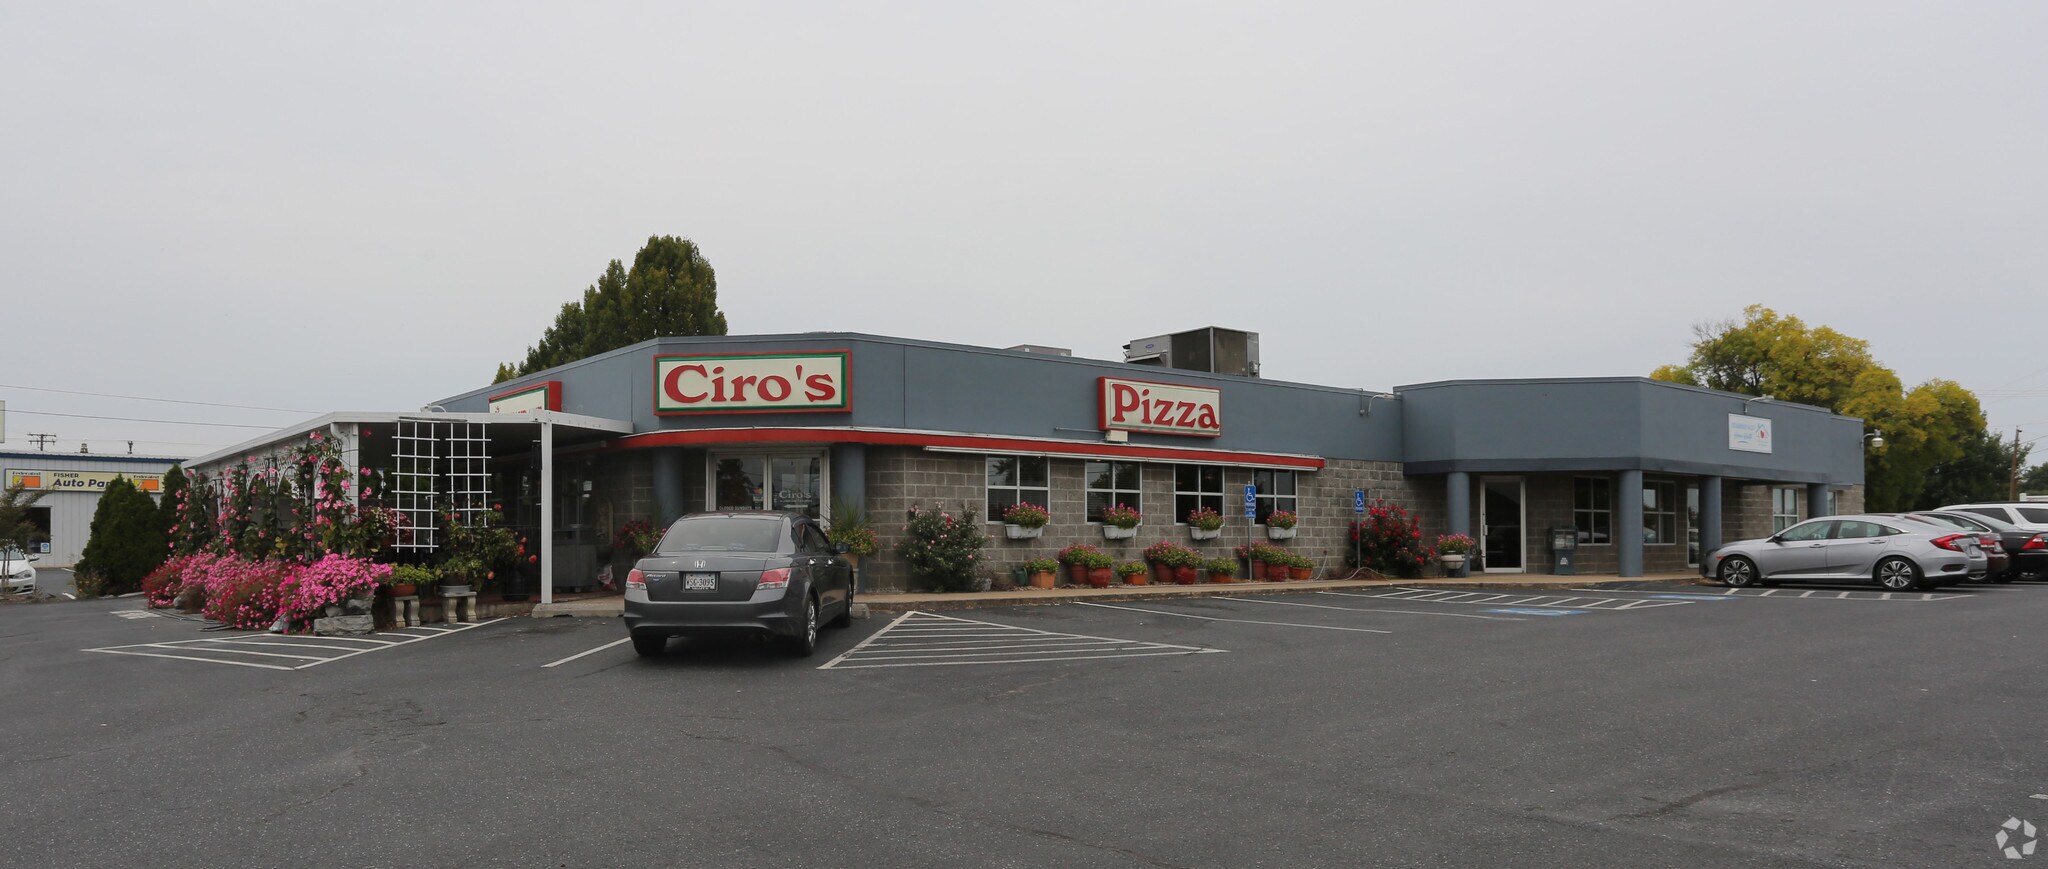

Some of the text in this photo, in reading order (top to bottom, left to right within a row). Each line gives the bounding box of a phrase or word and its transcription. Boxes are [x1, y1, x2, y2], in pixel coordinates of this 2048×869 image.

[664, 363, 836, 403] Ciro's
[1111, 383, 1220, 429] Pizza
[53, 479, 85, 487] Auto
[779, 490, 812, 499] Ciro's
